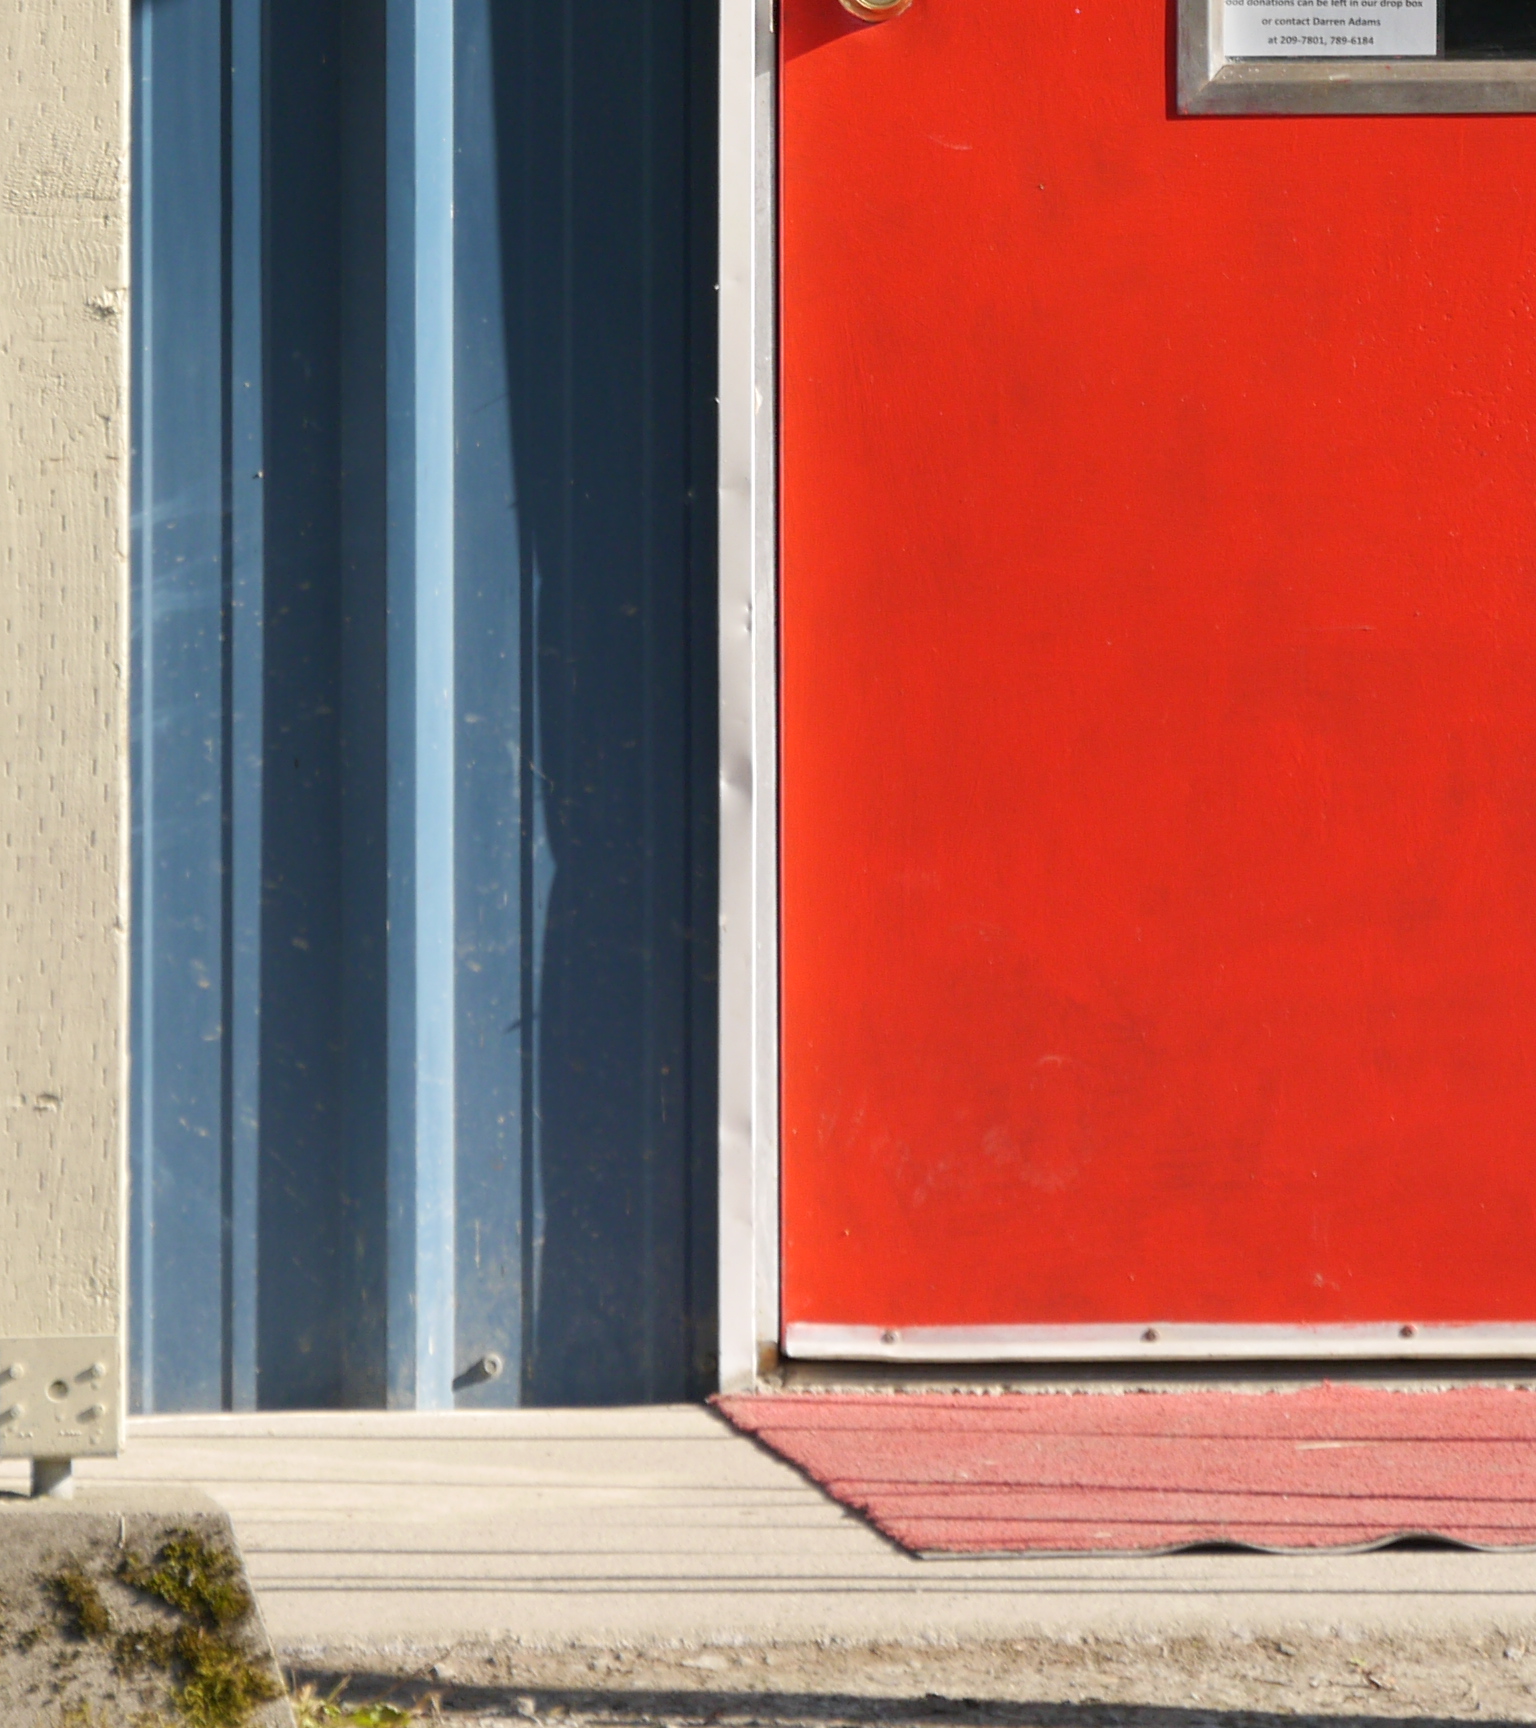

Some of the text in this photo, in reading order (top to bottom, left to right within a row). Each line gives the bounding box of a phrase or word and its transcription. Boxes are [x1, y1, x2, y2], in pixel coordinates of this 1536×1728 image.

[1296, 0, 1315, 7] can
[1360, 0, 1378, 8] our
[1261, 16, 1382, 27] or contact Darren Adams
[1267, 35, 1278, 45] at
[1329, 35, 1375, 46] 789-6184
